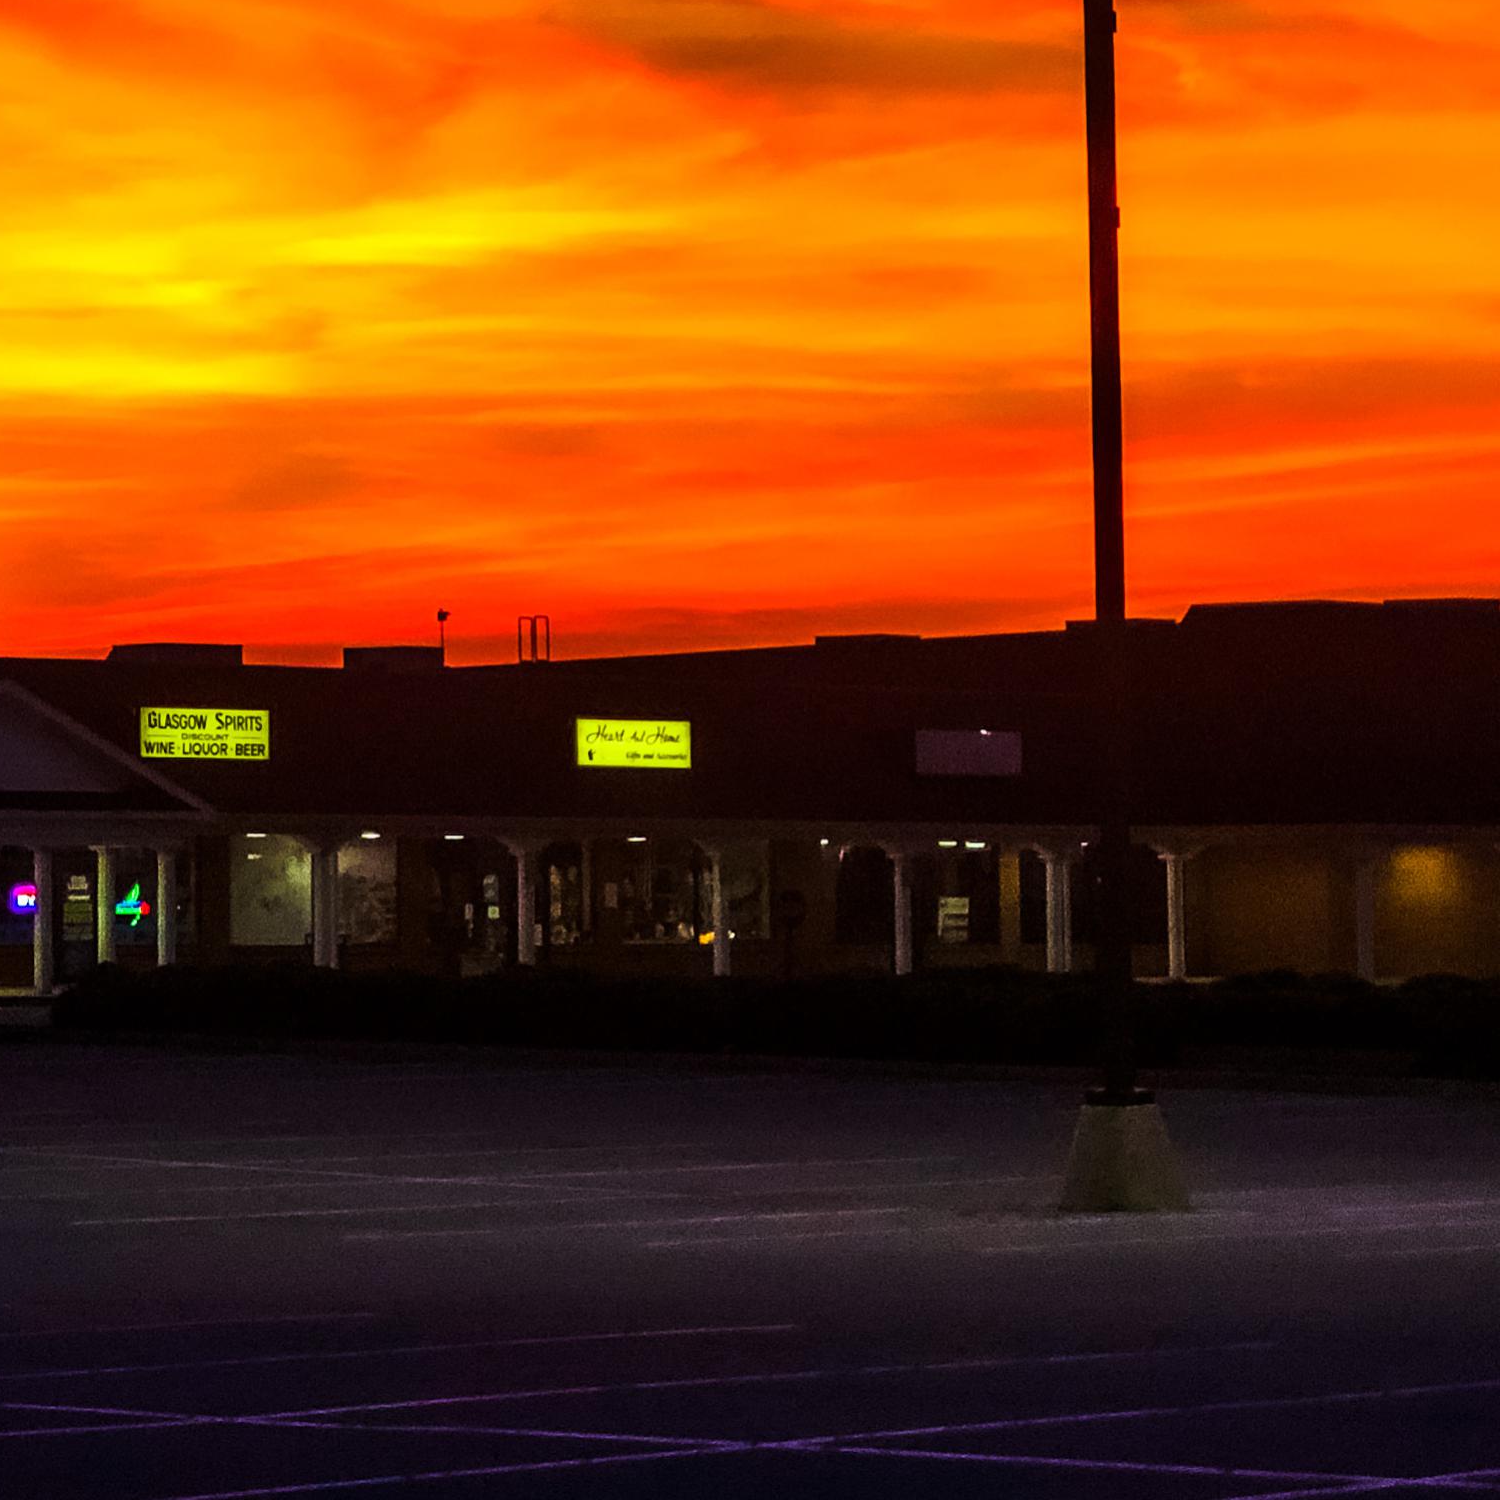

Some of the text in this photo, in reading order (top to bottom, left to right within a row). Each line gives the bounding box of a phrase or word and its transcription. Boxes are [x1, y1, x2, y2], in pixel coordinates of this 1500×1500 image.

[147, 710, 263, 731] GLASGOW SPIRITS
[181, 732, 229, 741] DISCOUNT
[144, 740, 265, 757] WINE LIQUOR BEER
